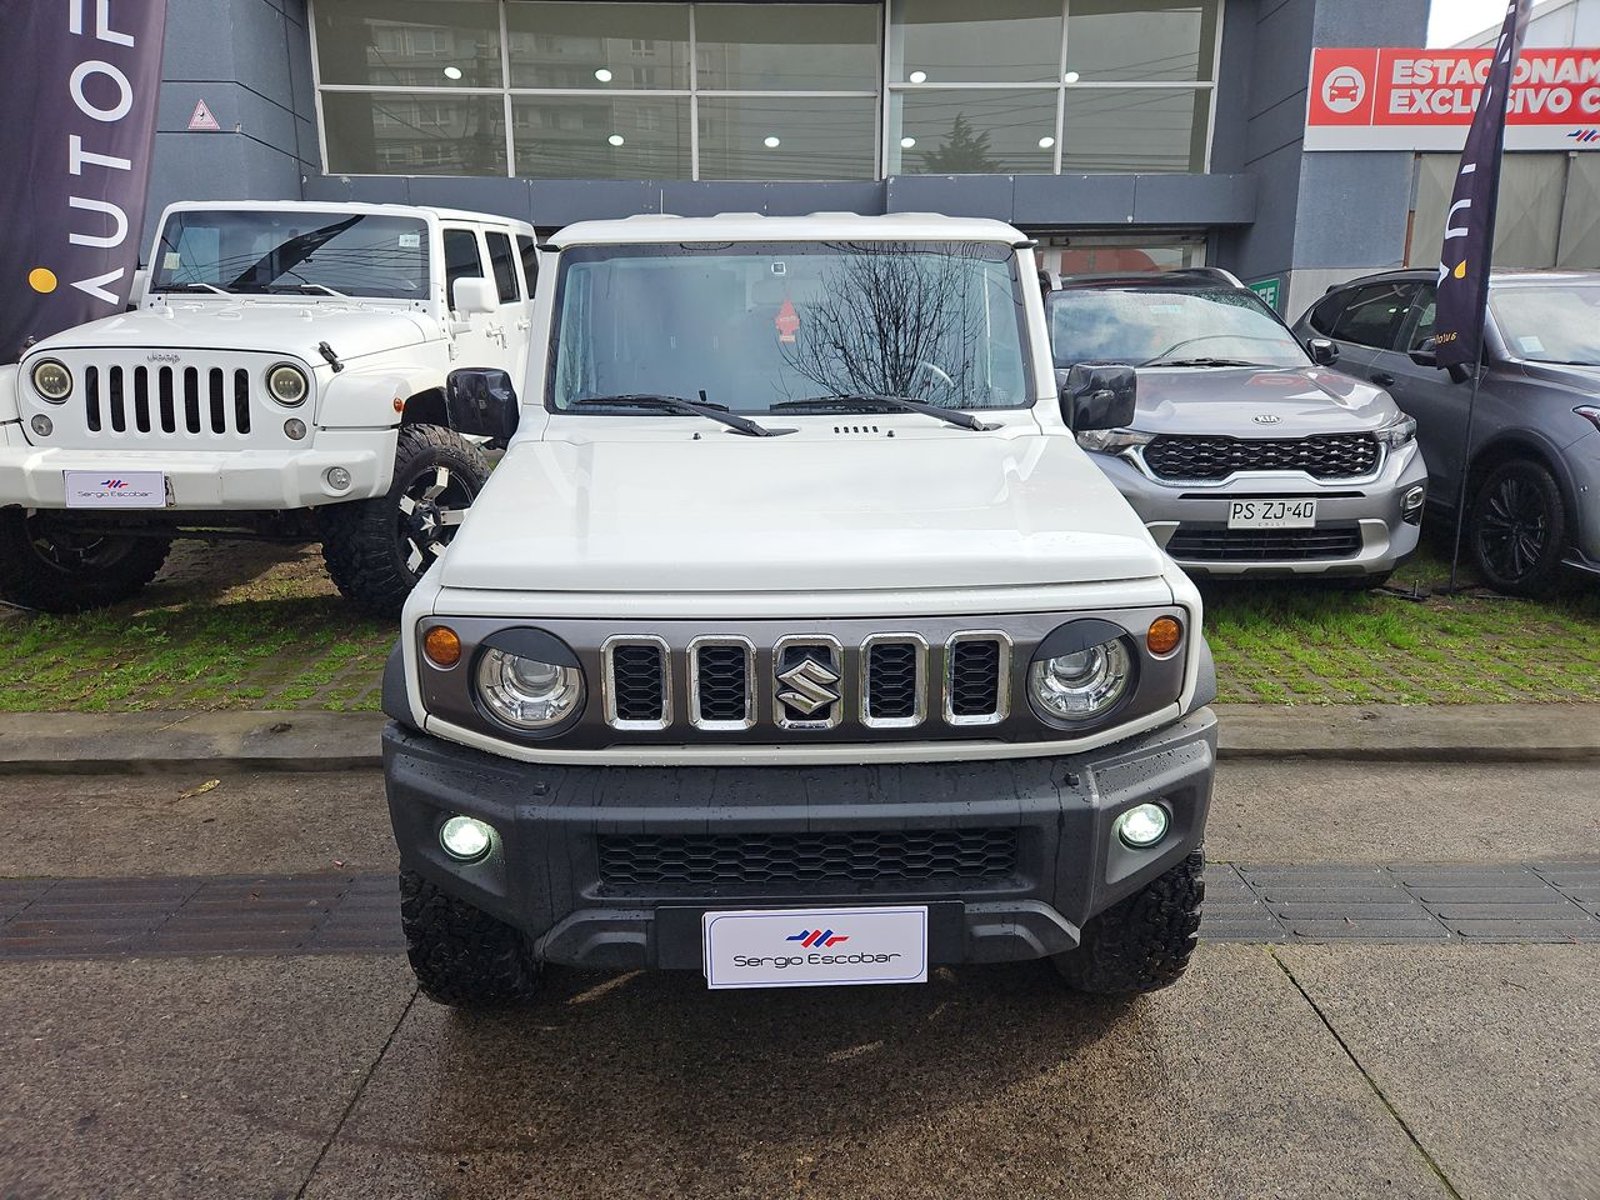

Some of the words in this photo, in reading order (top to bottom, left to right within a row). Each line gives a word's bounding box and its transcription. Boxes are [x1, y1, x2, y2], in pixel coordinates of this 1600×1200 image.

[1391, 57, 1600, 85] ESTACONAM
[147, 351, 181, 364] Jeep
[1254, 415, 1280, 424] KIA
[110, 490, 153, 498] Escobar
[733, 954, 804, 969] Sergio
[807, 951, 902, 964] Escobar
